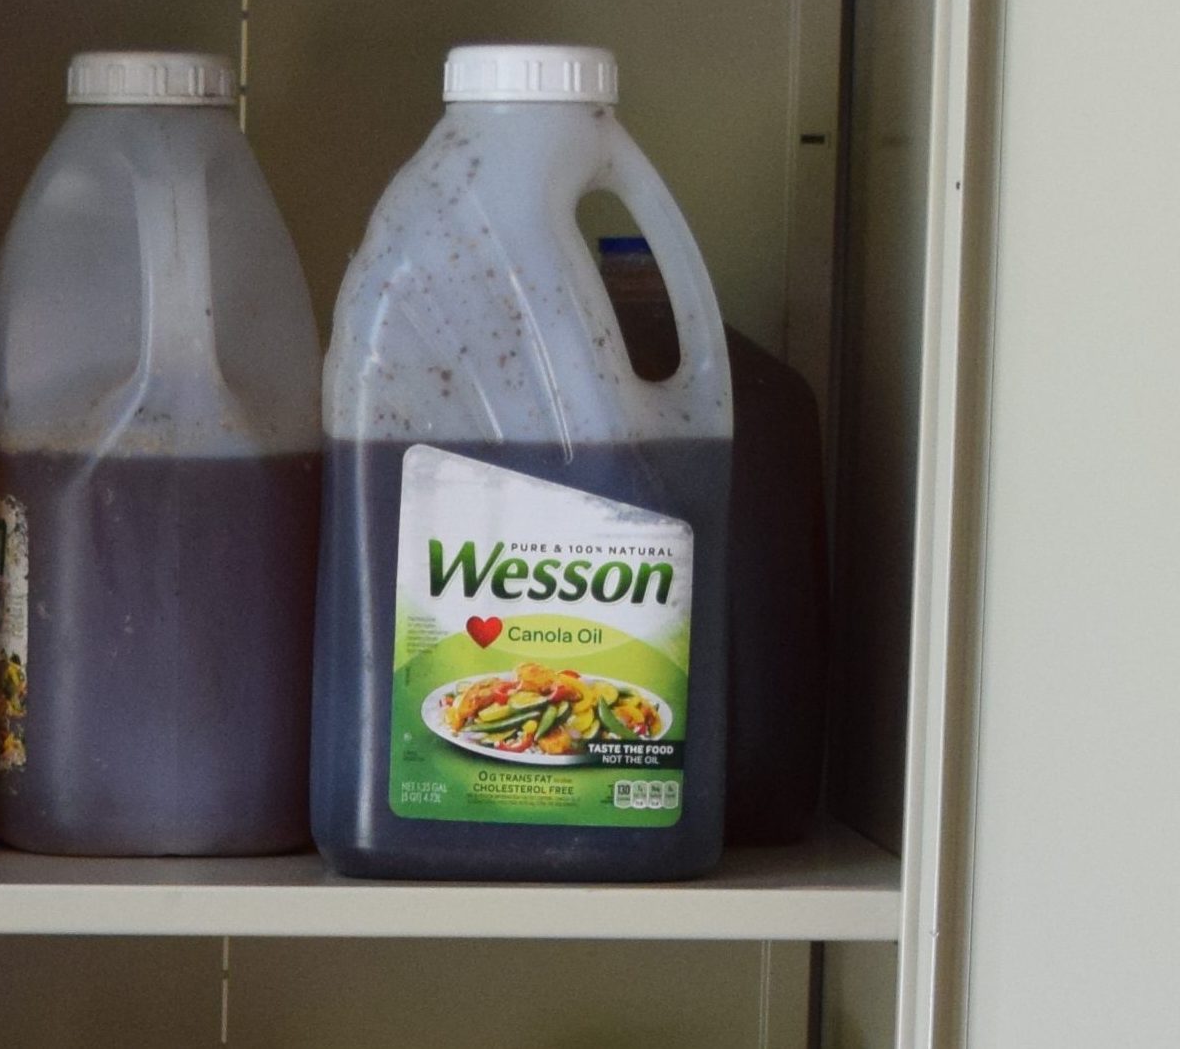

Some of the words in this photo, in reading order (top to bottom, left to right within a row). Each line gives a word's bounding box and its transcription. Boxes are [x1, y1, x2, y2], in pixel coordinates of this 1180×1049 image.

[511, 543, 547, 553] PURE
[554, 544, 562, 553] &
[569, 545, 603, 554] 100%
[609, 546, 673, 557] NATURAL
[428, 539, 674, 605] Wesson
[508, 626, 572, 643] Canola
[577, 628, 602, 644] Oil
[588, 743, 621, 754] TASTE
[623, 744, 643, 754] THE
[645, 745, 674, 755] FOOD
[602, 755, 622, 764] NOT
[624, 755, 643, 764] THE
[644, 755, 659, 765] OIL
[499, 773, 532, 783] TRANS
[534, 774, 553, 784] FAT
[473, 783, 546, 794] CHOLESTEROL
[549, 785, 575, 795] FREE
[617, 784, 631, 795] 130
